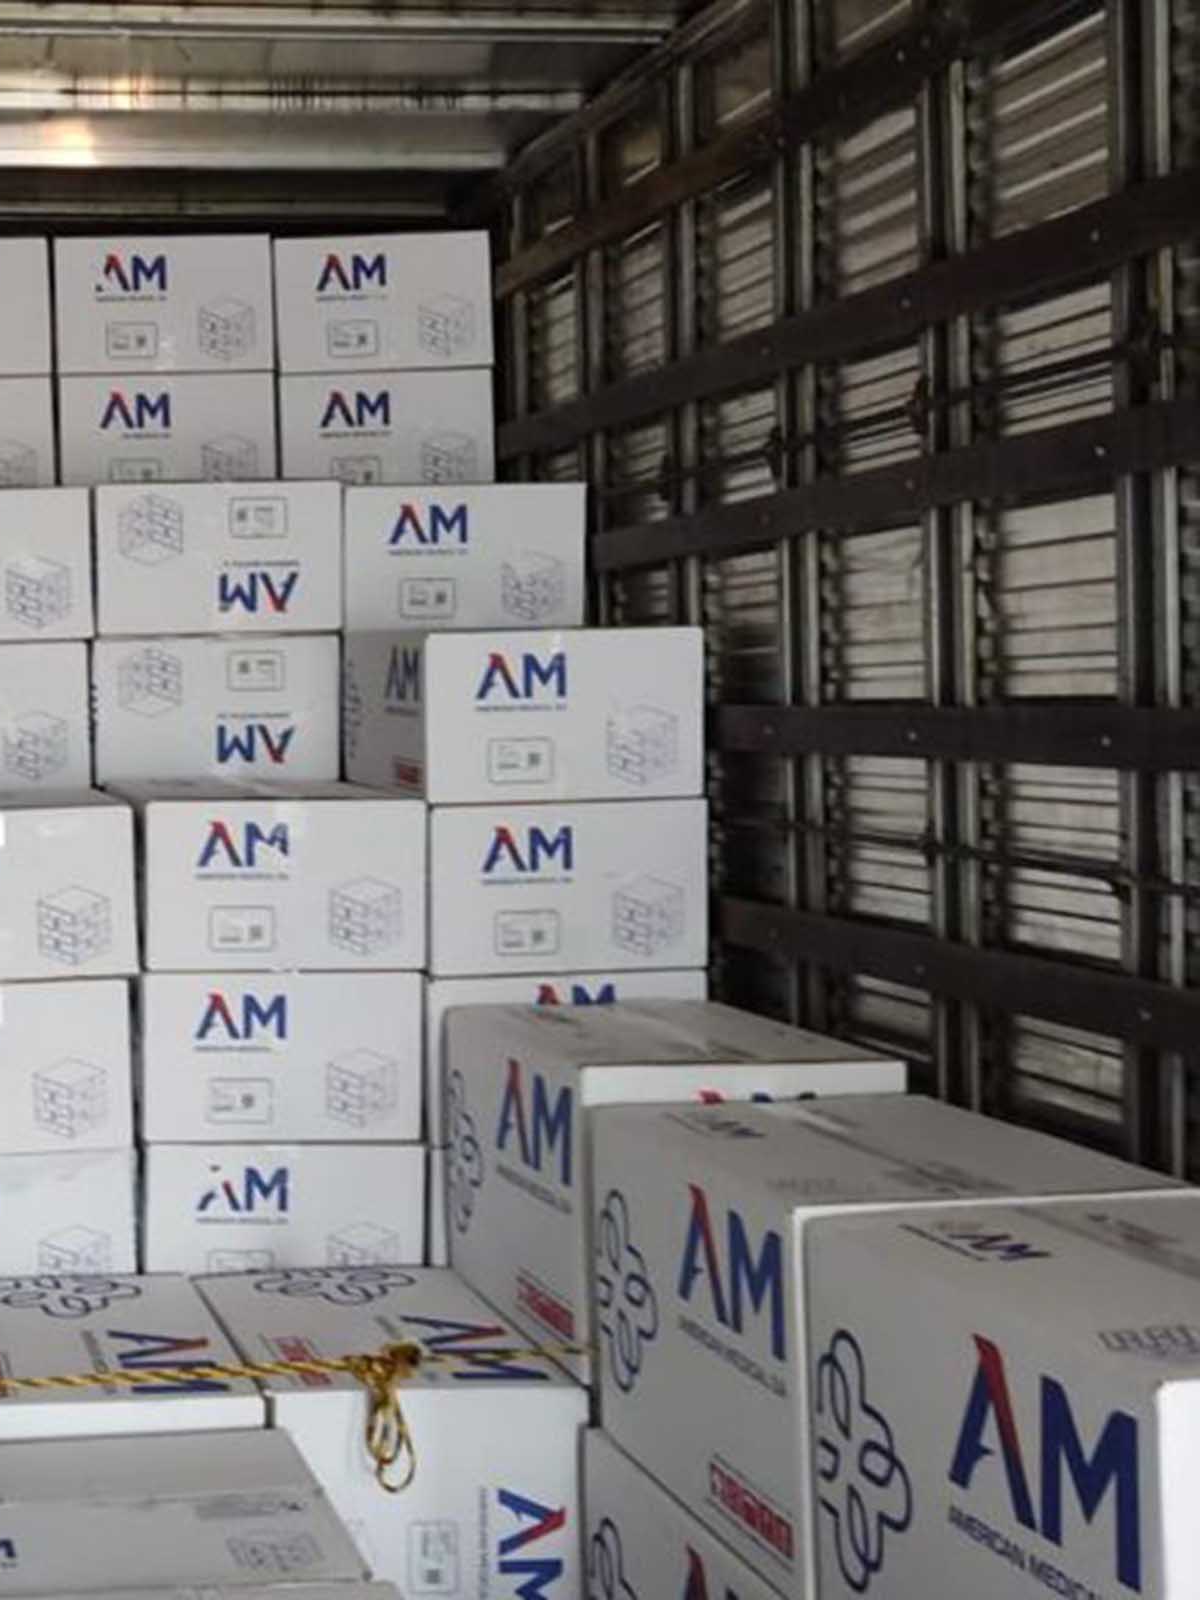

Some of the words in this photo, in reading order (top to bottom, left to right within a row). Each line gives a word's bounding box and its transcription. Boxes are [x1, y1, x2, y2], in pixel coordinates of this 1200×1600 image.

[96, 254, 167, 292] AM
[316, 254, 386, 292] AM
[100, 392, 171, 429] AM
[320, 391, 390, 428] AM
[389, 504, 468, 545] AM
[219, 571, 299, 613] AM
[384, 644, 420, 701] AM
[476, 653, 566, 700] AM
[217, 724, 294, 764] AM
[197, 821, 289, 867] AM
[483, 826, 573, 873] AM
[196, 993, 286, 1040] AM
[497, 1058, 574, 1188] AM
[197, 1165, 289, 1212] AM
[678, 1183, 787, 1362] AM
[107, 1329, 230, 1393] AM
[400, 1314, 549, 1381] AM
[948, 1333, 1143, 1594] AM
[497, 1488, 567, 1600] AM
